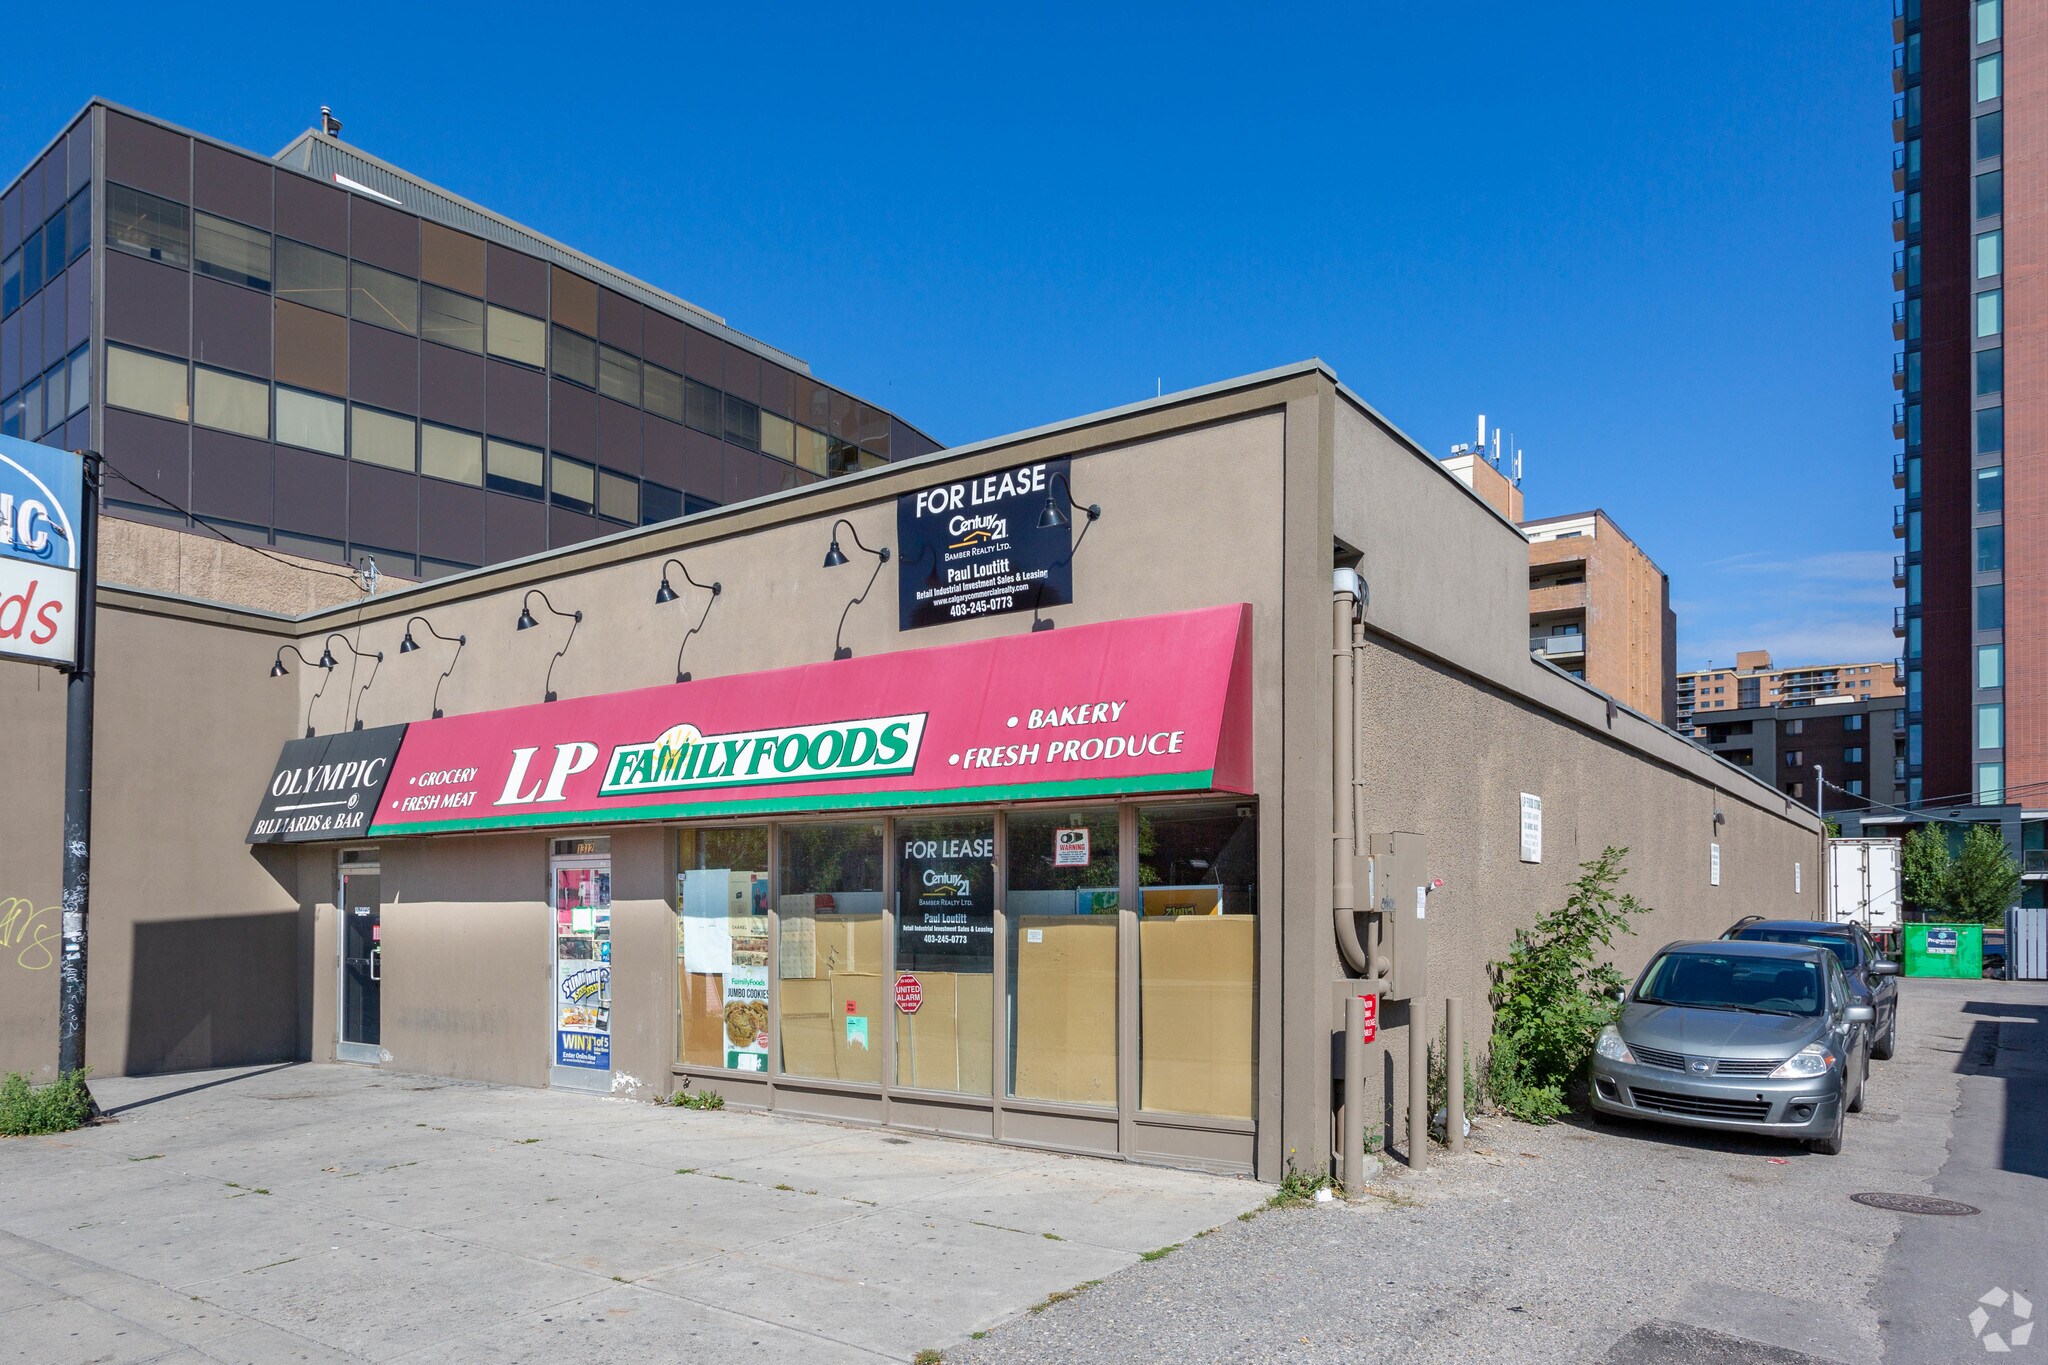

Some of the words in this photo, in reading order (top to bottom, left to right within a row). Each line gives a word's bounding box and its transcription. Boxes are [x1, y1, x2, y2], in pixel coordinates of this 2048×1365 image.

[916, 484, 965, 518] FOR
[971, 464, 1046, 506] LEASE
[949, 513, 998, 536] Century
[991, 518, 1007, 541] 21
[945, 550, 970, 561] BAMBER
[971, 545, 995, 556] REALTY
[948, 565, 970, 582] Paul
[974, 559, 1009, 578] Loutitt
[916, 589, 932, 600] Retail
[934, 584, 962, 596] Industrial
[963, 578, 996, 591] Investment
[997, 575, 1014, 585] Sales
[1016, 573, 1021, 581] &
[1022, 569, 1048, 579] Leasing
[0, 580, 62, 644] ds
[950, 596, 1013, 617] 403-245-0773
[1027, 700, 1128, 730] BAKERY
[963, 743, 1041, 769] FRESH
[1046, 731, 1185, 763] PRODUCE
[272, 757, 387, 797] OLYMPIC
[418, 767, 479, 787] GROCERY
[493, 742, 599, 806] LP
[401, 795, 438, 812] FRESH
[440, 791, 477, 808] MEAT
[254, 815, 323, 834] BILLIARDS
[321, 816, 332, 830] &
[334, 812, 364, 829] BAR
[905, 841, 937, 859] FOR
[942, 839, 993, 858] LEASE
[923, 869, 962, 886] Century
[957, 880, 970, 896] 21
[924, 913, 940, 923] Paul
[942, 914, 967, 923] Loutitt
[924, 935, 967, 944] 403-245-0773
[727, 988, 746, 999] JUMBO
[746, 989, 768, 1000] COOKIES
[896, 985, 920, 993] UNITED
